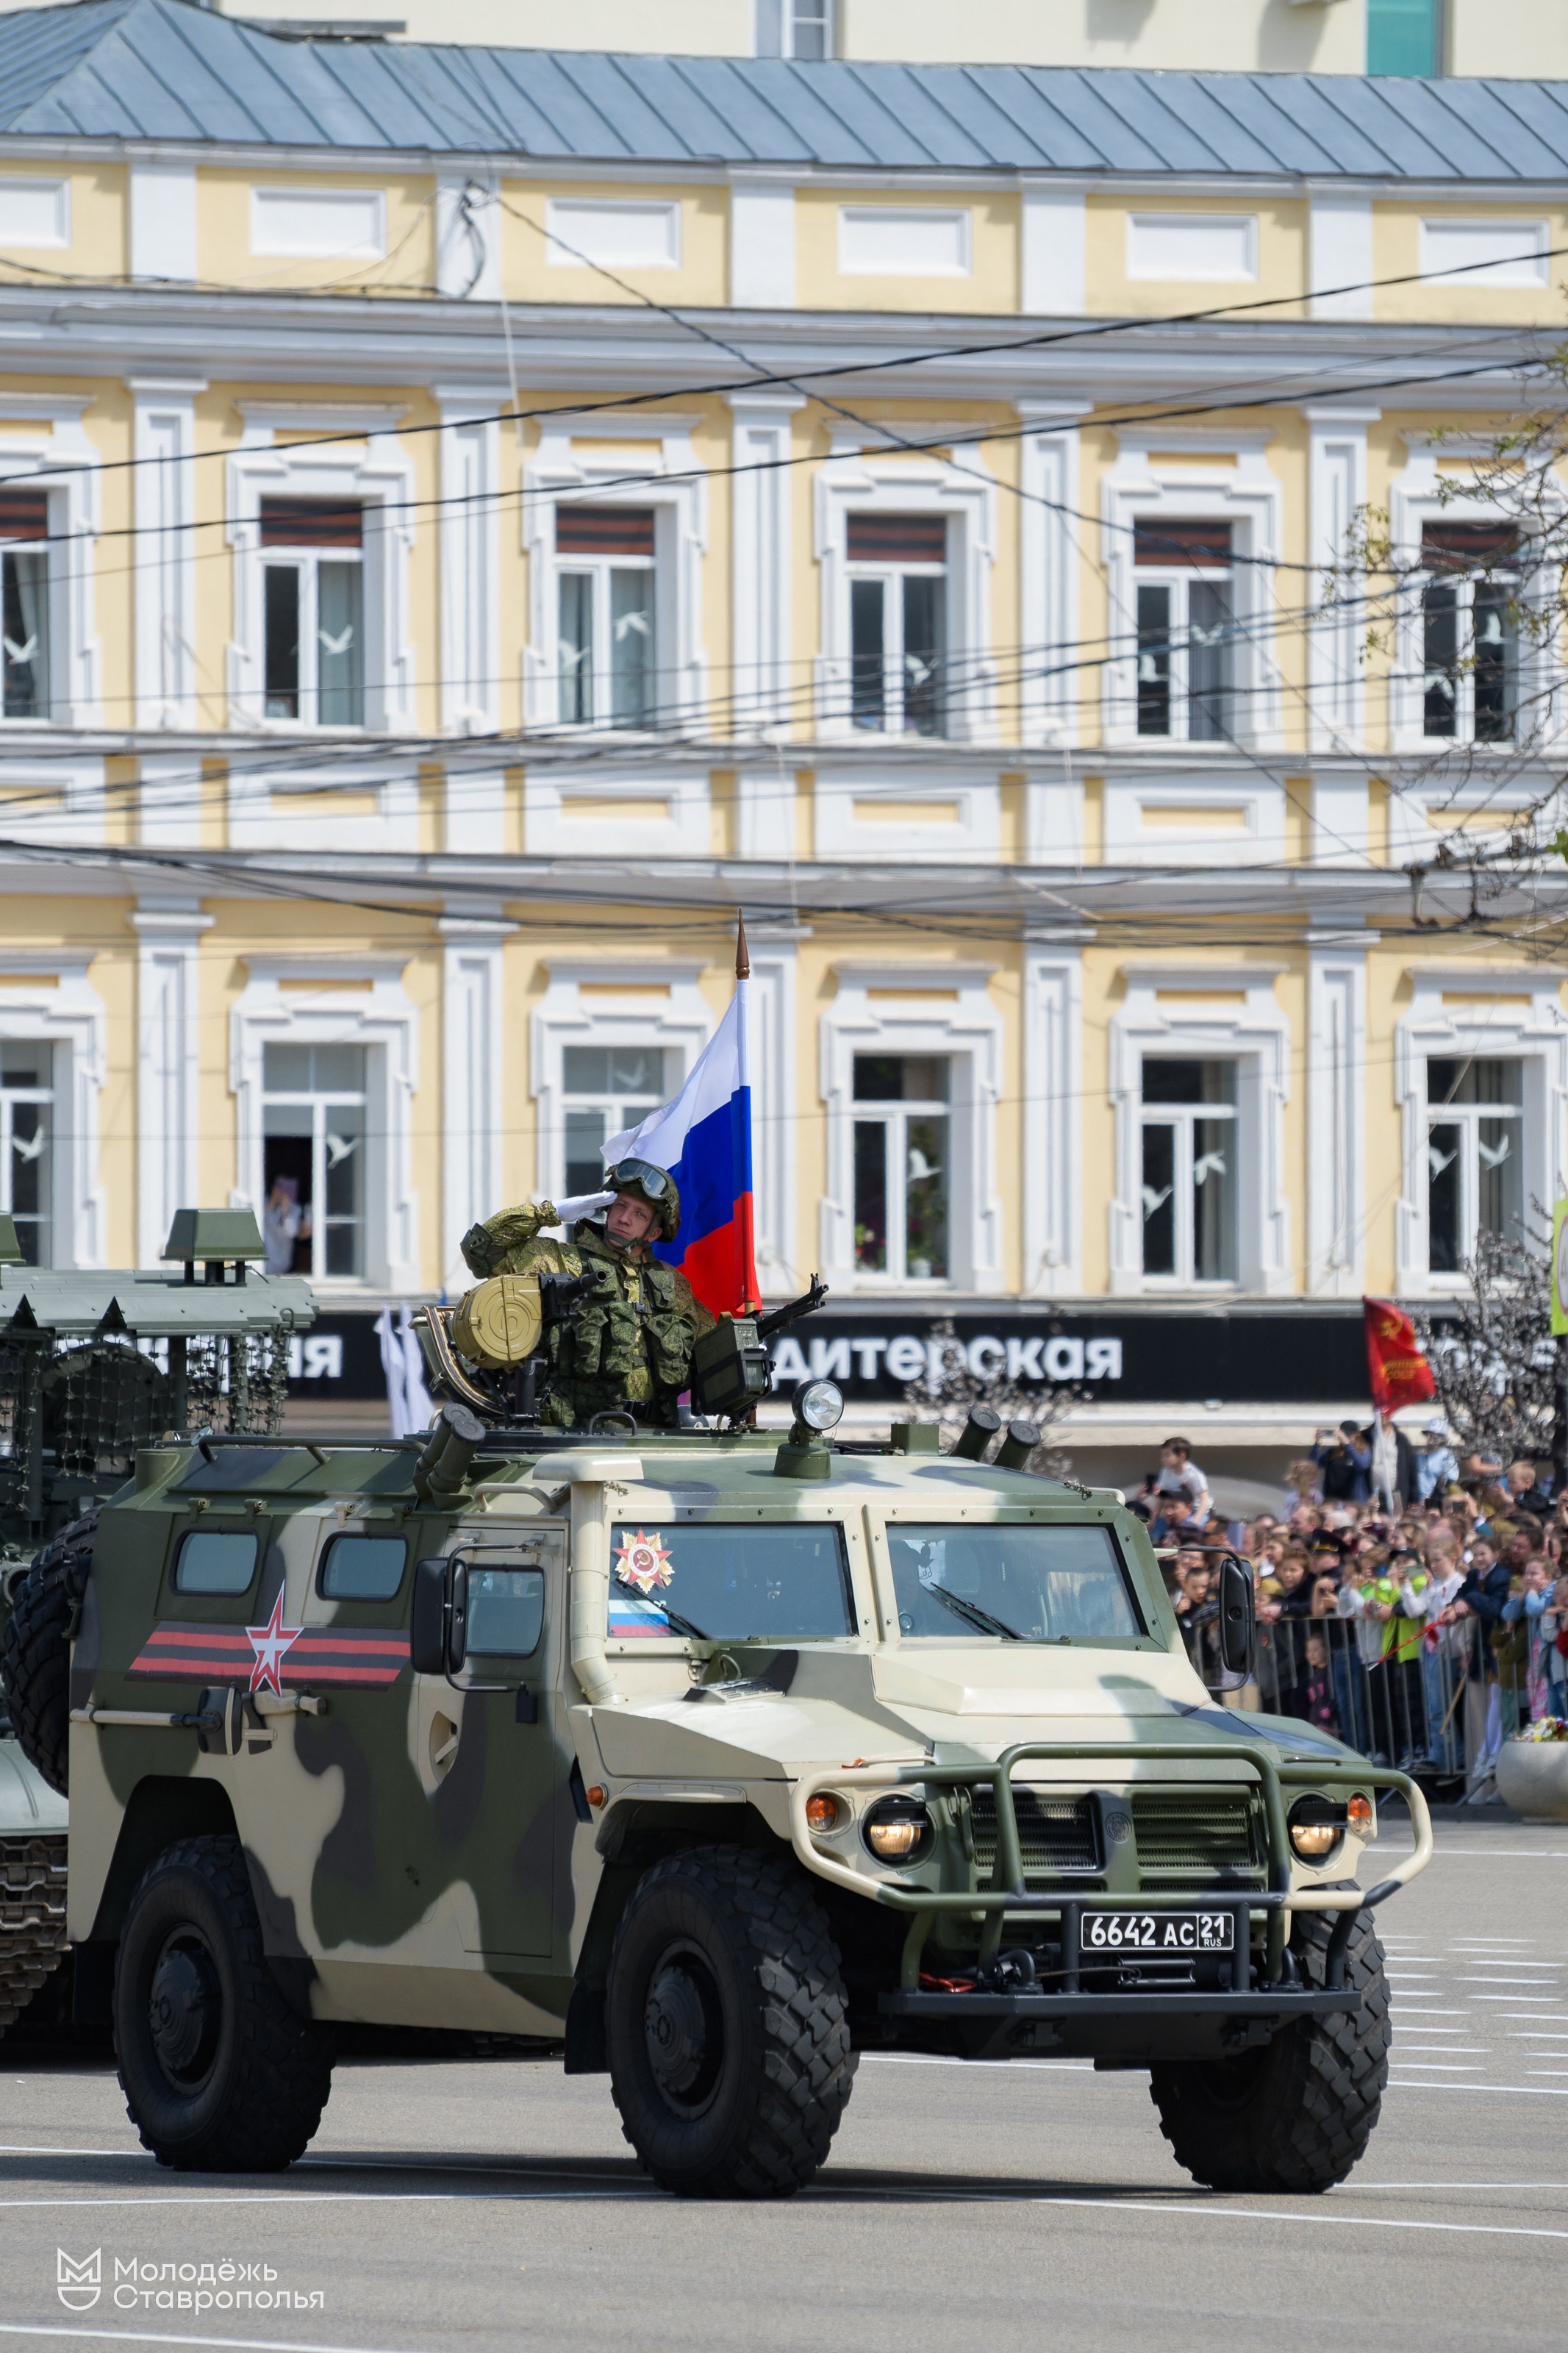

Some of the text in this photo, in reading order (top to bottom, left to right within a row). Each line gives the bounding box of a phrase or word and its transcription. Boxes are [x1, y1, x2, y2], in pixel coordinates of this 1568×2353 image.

[770, 1335, 1123, 1396] дитерская
[1091, 1915, 1225, 1946] 6642 АС 21
[1204, 1938, 1222, 1947] RUS
